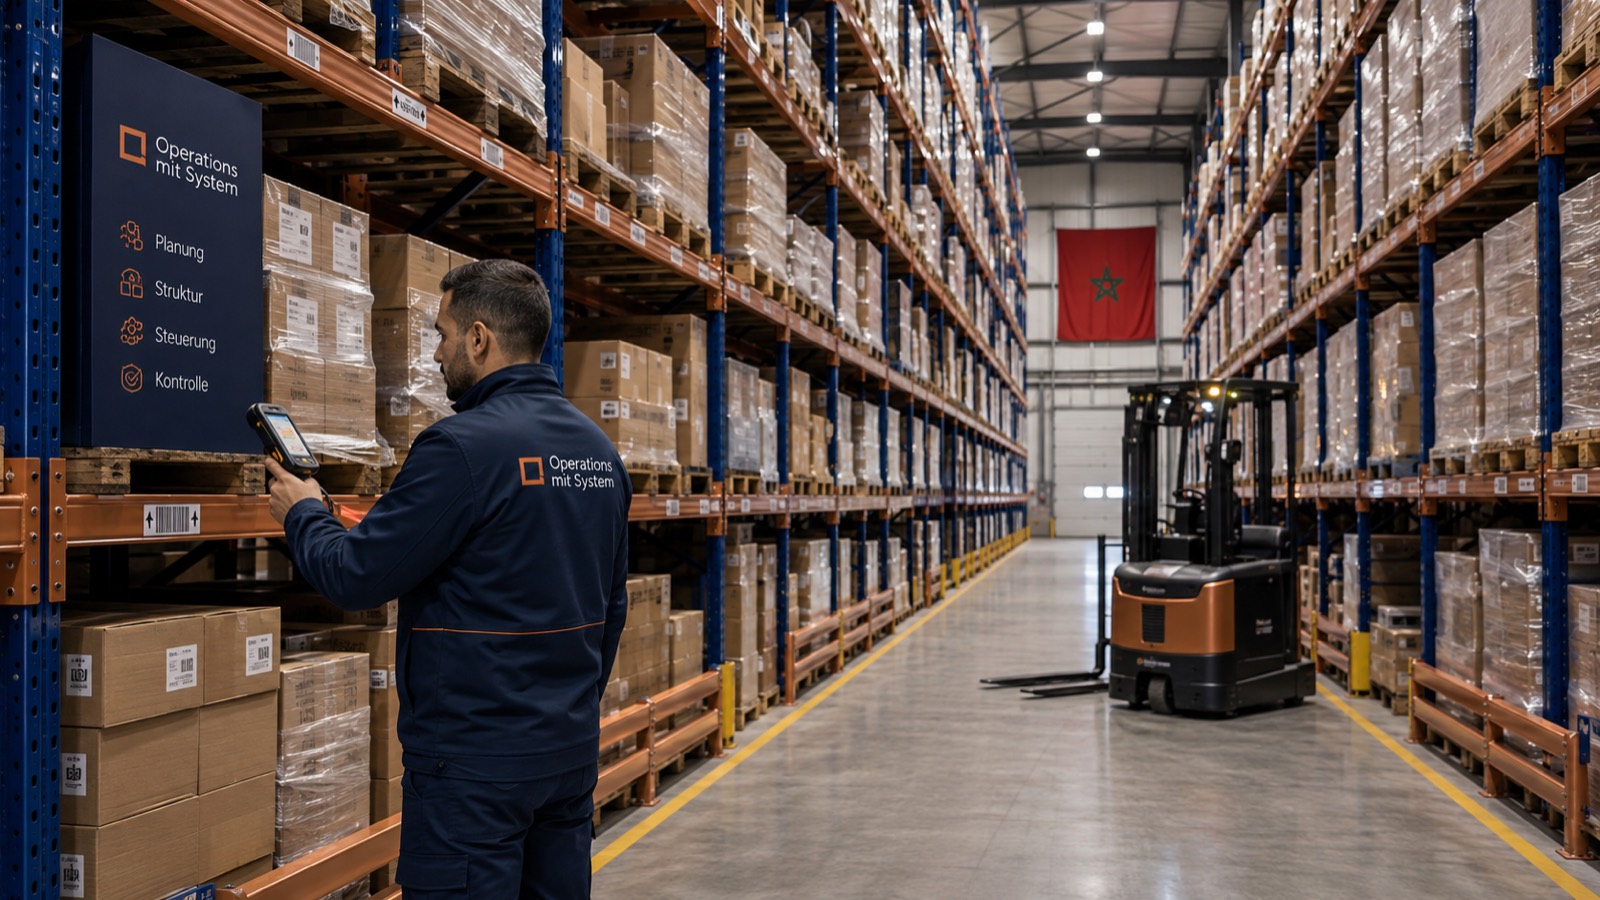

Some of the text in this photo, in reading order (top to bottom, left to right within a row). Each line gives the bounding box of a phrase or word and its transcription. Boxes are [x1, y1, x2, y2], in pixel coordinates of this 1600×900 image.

[155, 136, 238, 178] Operations
[156, 159, 238, 197] mit System
[155, 234, 204, 263] Planung
[155, 280, 203, 304] Struktur
[155, 326, 216, 354] Steuerung
[155, 371, 209, 392] Kontrolle
[549, 454, 613, 473] Operations
[551, 472, 615, 491] mit System
